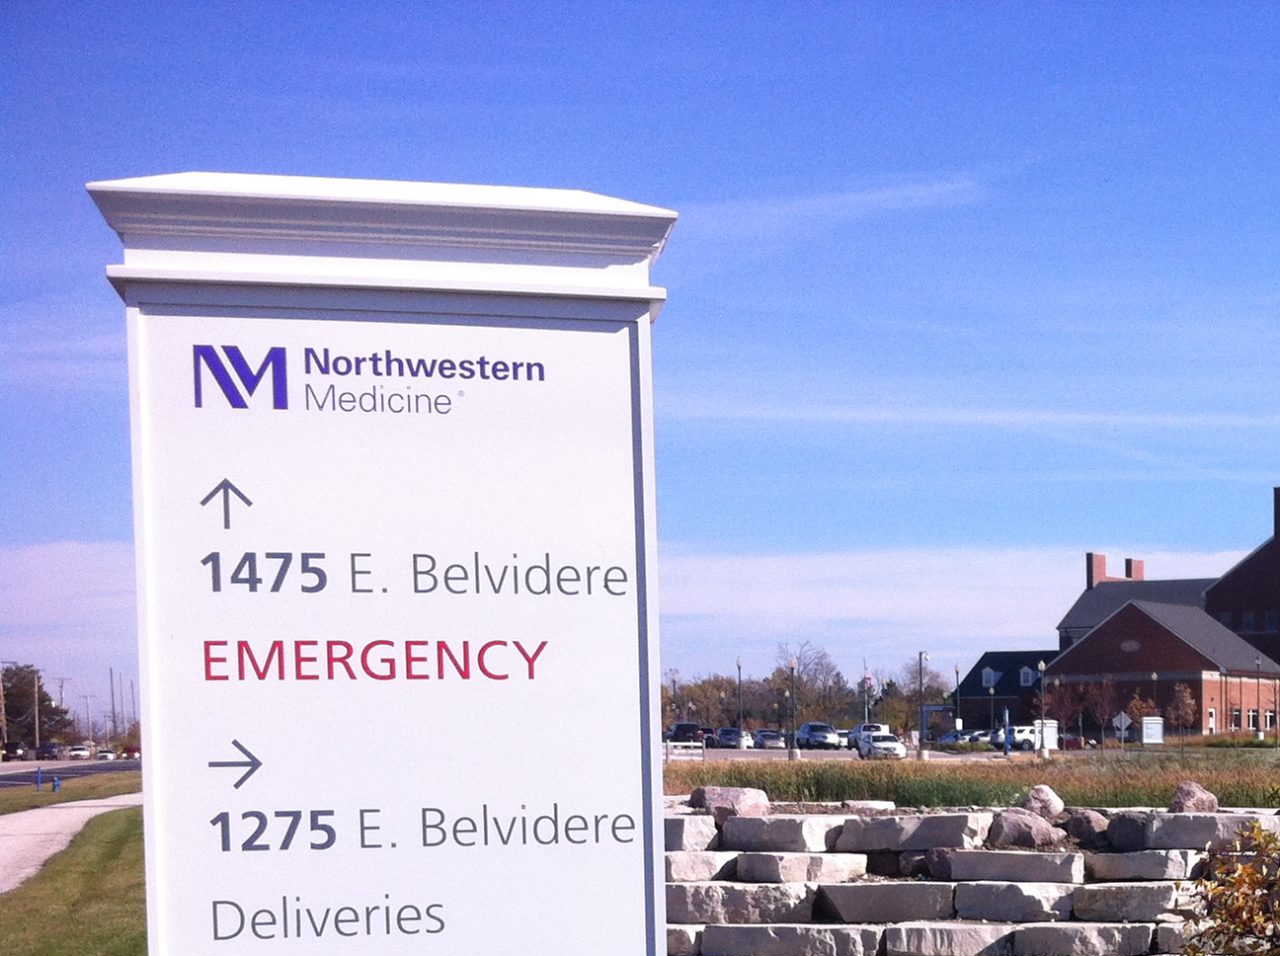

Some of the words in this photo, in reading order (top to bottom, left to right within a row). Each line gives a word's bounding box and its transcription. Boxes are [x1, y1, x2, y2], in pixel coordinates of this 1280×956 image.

[304, 347, 545, 381] Northwestern
[201, 552, 328, 593] 1475
[351, 553, 388, 593] E.
[413, 552, 628, 596] Belvidere
[204, 640, 548, 681] EMERGENCY
[210, 810, 337, 852] 1275
[360, 809, 397, 849] E.
[422, 803, 636, 848] Belvidere
[213, 894, 446, 941] Deliveries
